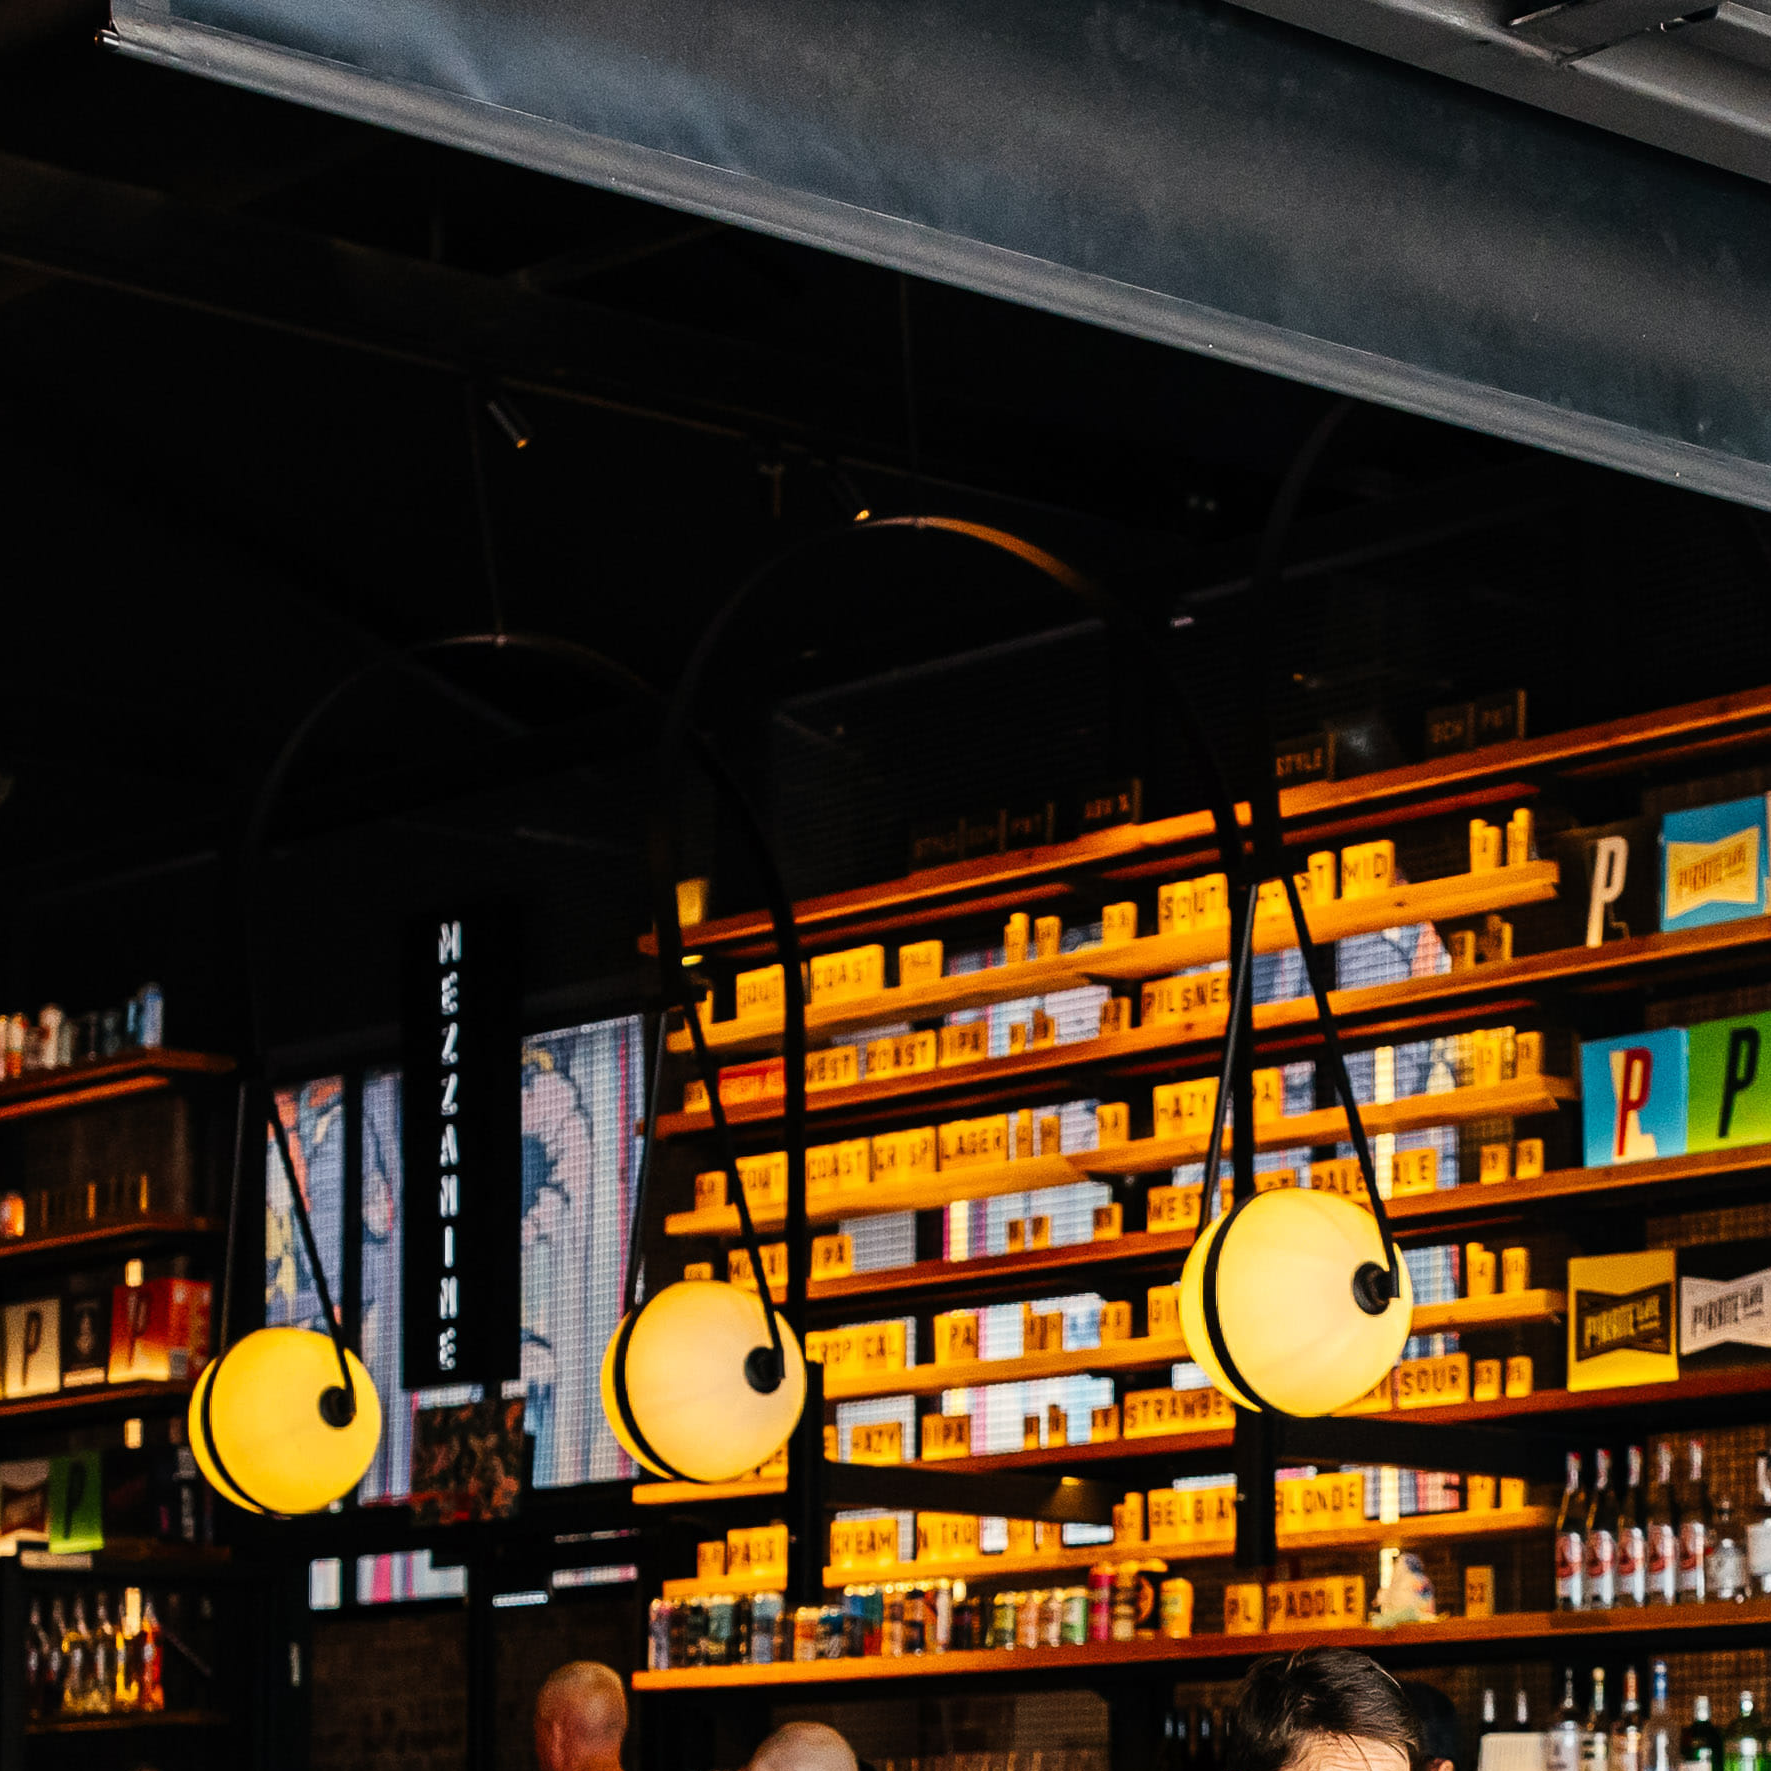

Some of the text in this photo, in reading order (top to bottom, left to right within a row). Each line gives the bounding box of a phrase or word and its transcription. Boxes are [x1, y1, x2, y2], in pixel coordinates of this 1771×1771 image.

[1586, 836, 1629, 948] P
[1144, 975, 1227, 1015] PILSNE
[1616, 1048, 1653, 1156] P
[1718, 1027, 1760, 1138] P
[439, 920, 461, 1370] MEZZANINE
[1399, 1364, 1464, 1396] SOUR
[1151, 1496, 1231, 1528] BELGIA
